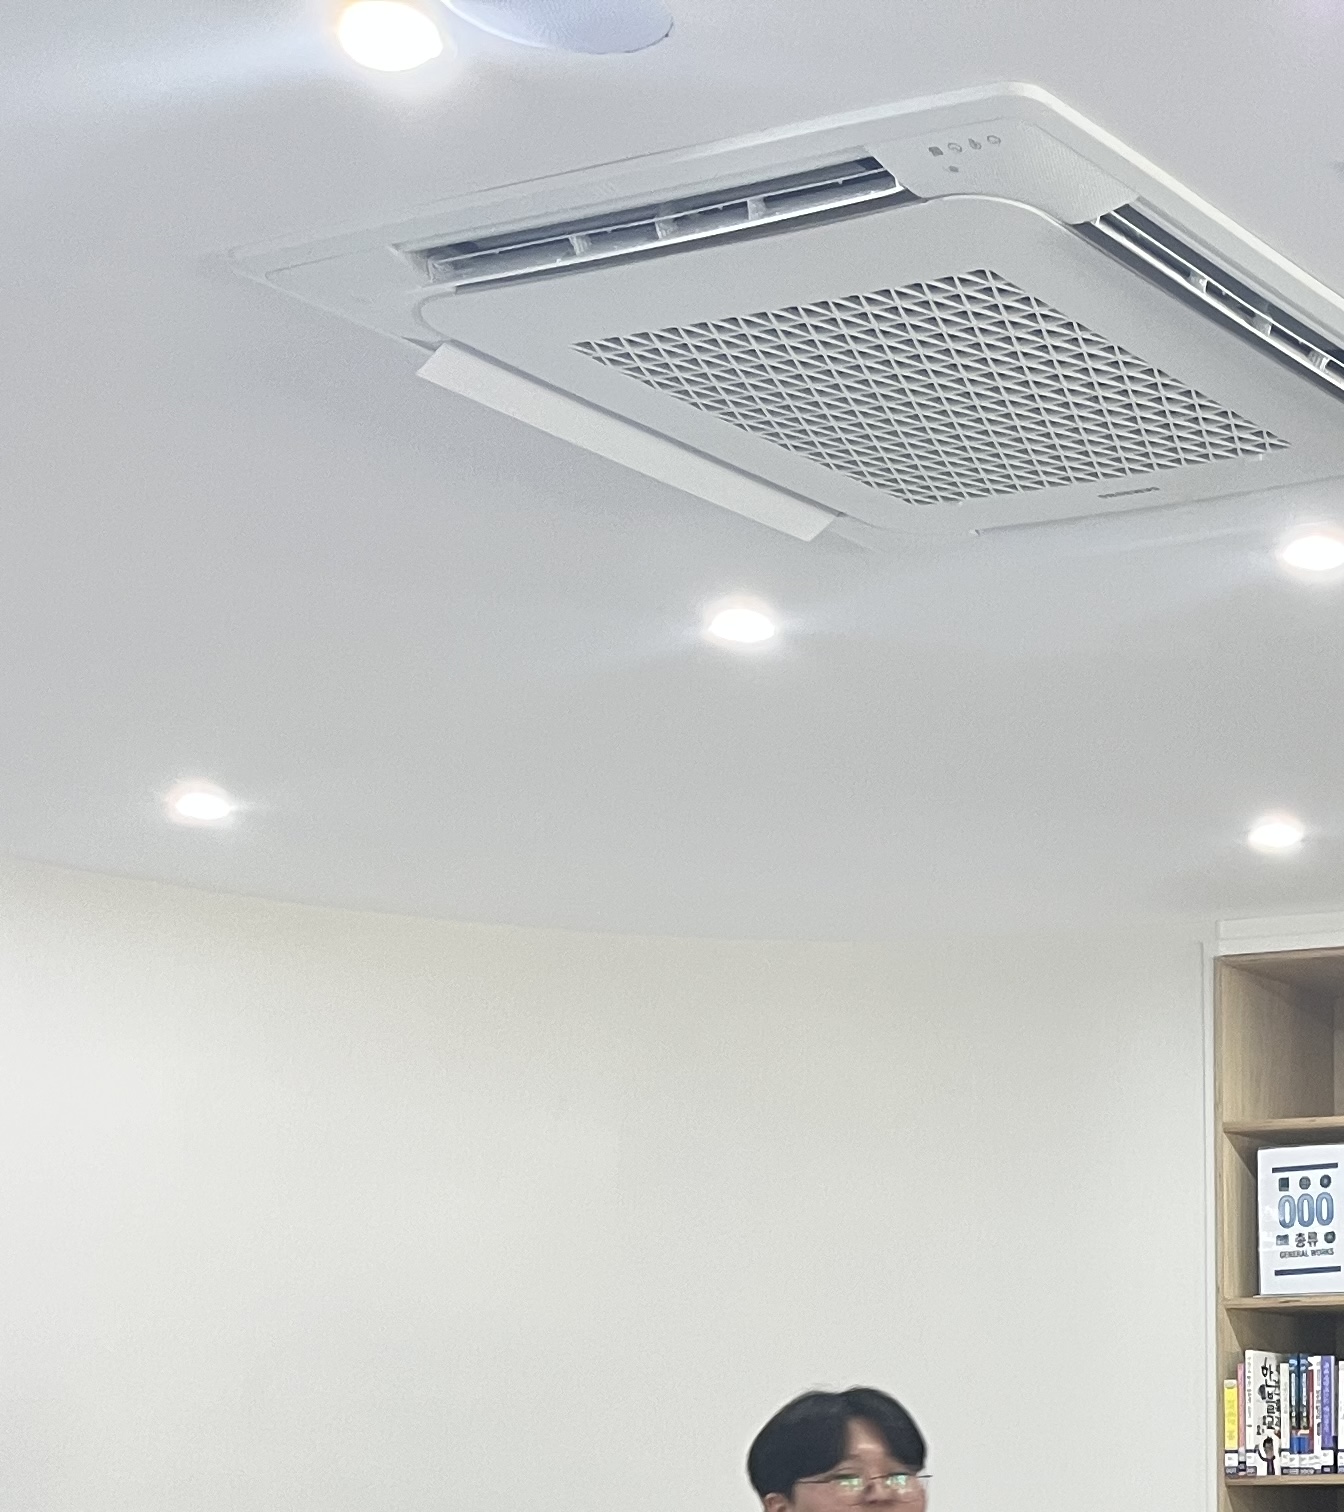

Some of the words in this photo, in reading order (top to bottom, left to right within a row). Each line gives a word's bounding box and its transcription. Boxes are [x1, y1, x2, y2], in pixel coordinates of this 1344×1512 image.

[1278, 1192, 1334, 1229] 000
[1279, 1249, 1309, 1259] GENERAL
[1311, 1247, 1334, 1257] WORKS
